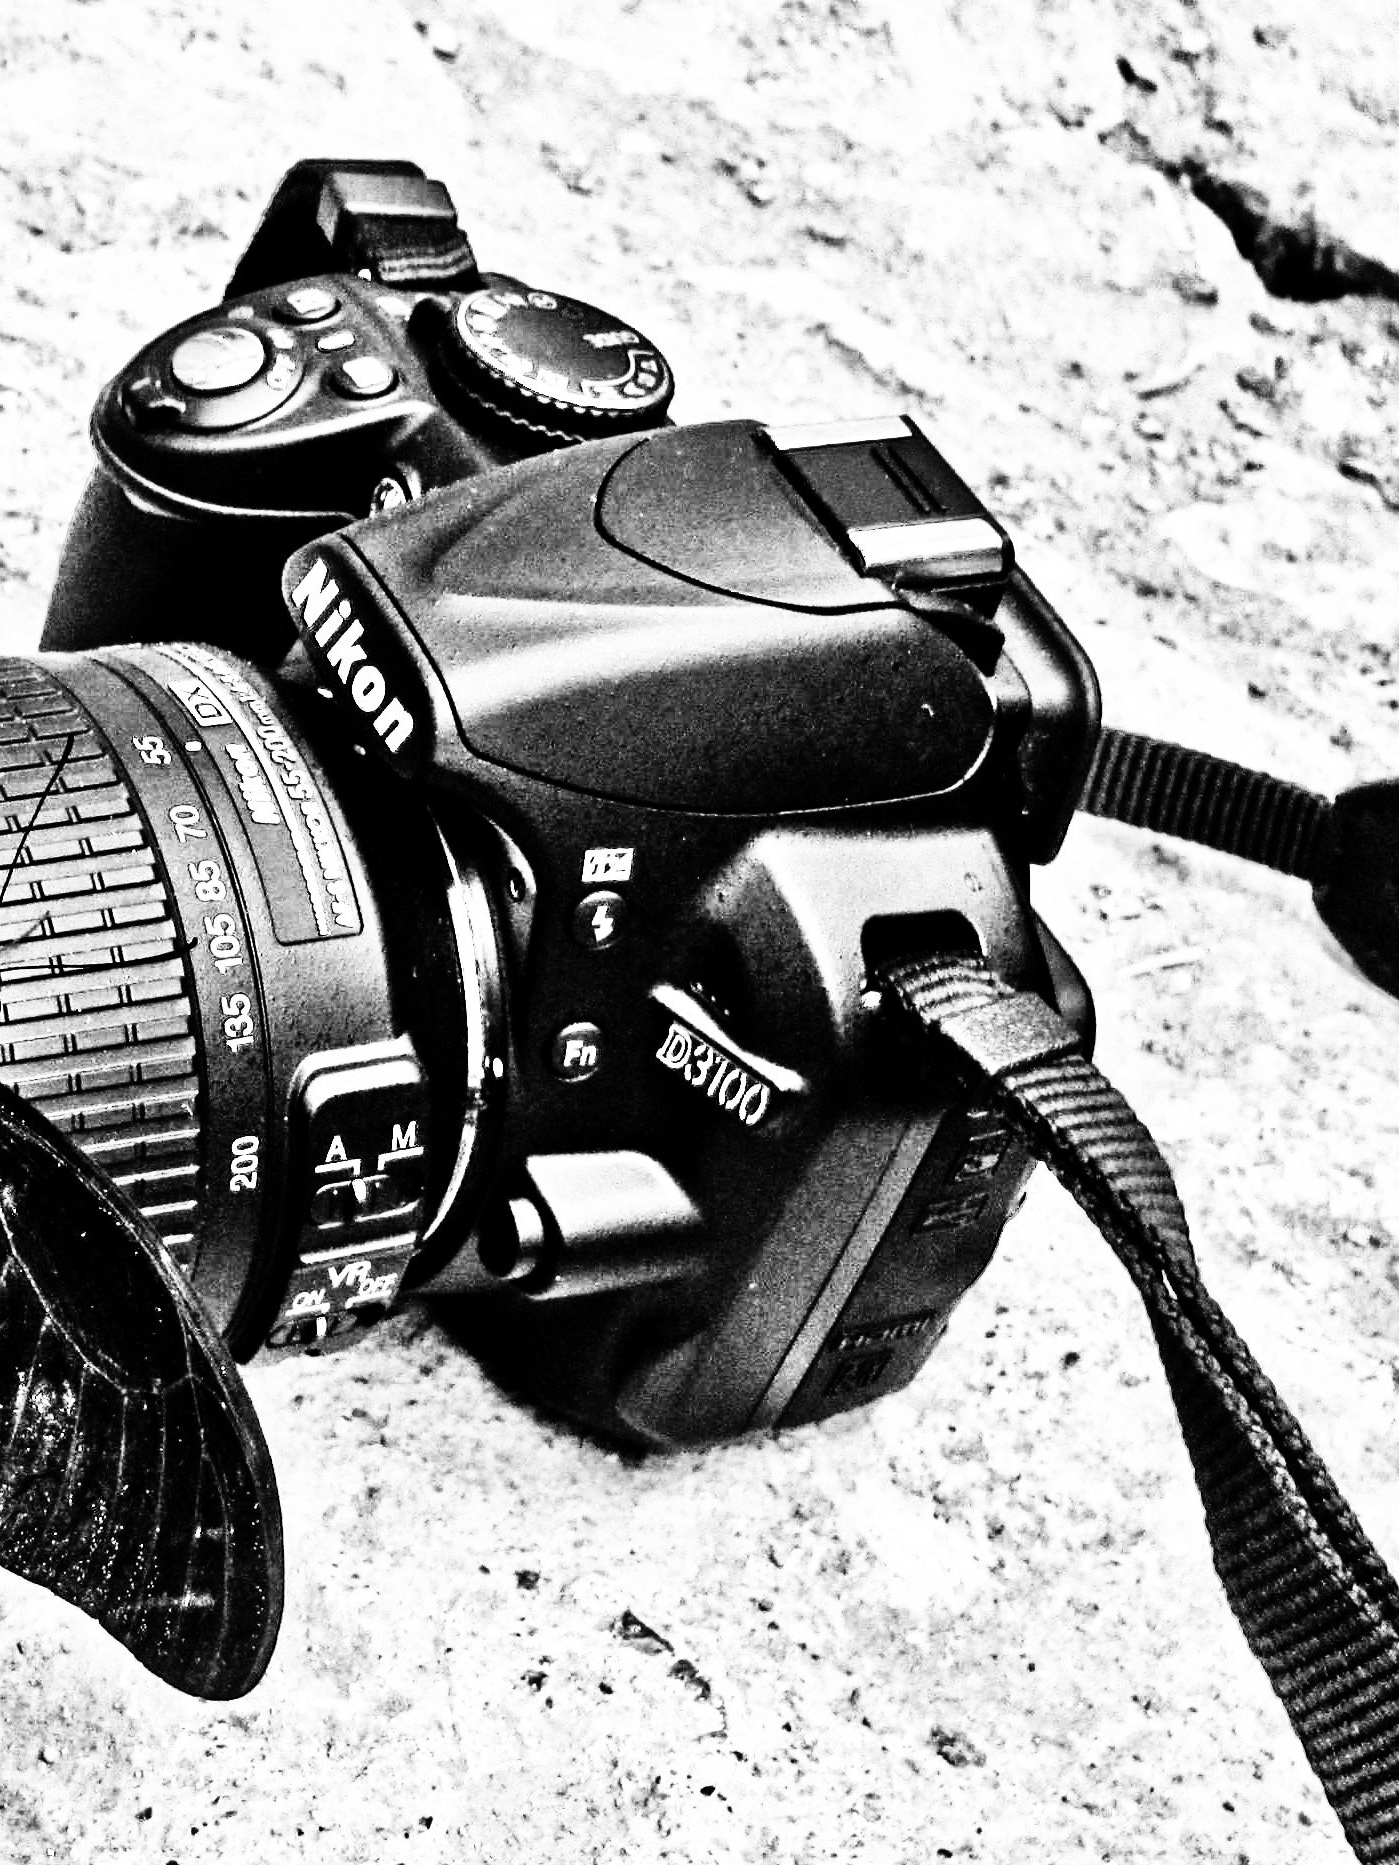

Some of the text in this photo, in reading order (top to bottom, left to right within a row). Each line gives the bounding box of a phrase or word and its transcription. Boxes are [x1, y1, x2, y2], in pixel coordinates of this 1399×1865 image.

[292, 557, 414, 754] Nikon
[132, 735, 172, 765] 55
[225, 743, 281, 825] Nikon
[169, 804, 207, 843] 70
[188, 860, 227, 901] 85
[204, 913, 243, 974] 105
[222, 992, 255, 1052] 135
[564, 1039, 597, 1067] Fn
[656, 1022, 770, 1125] D3100
[325, 1135, 348, 1162] A
[391, 1120, 417, 1150] M
[230, 1135, 259, 1192] 200
[328, 1260, 371, 1288] VR
